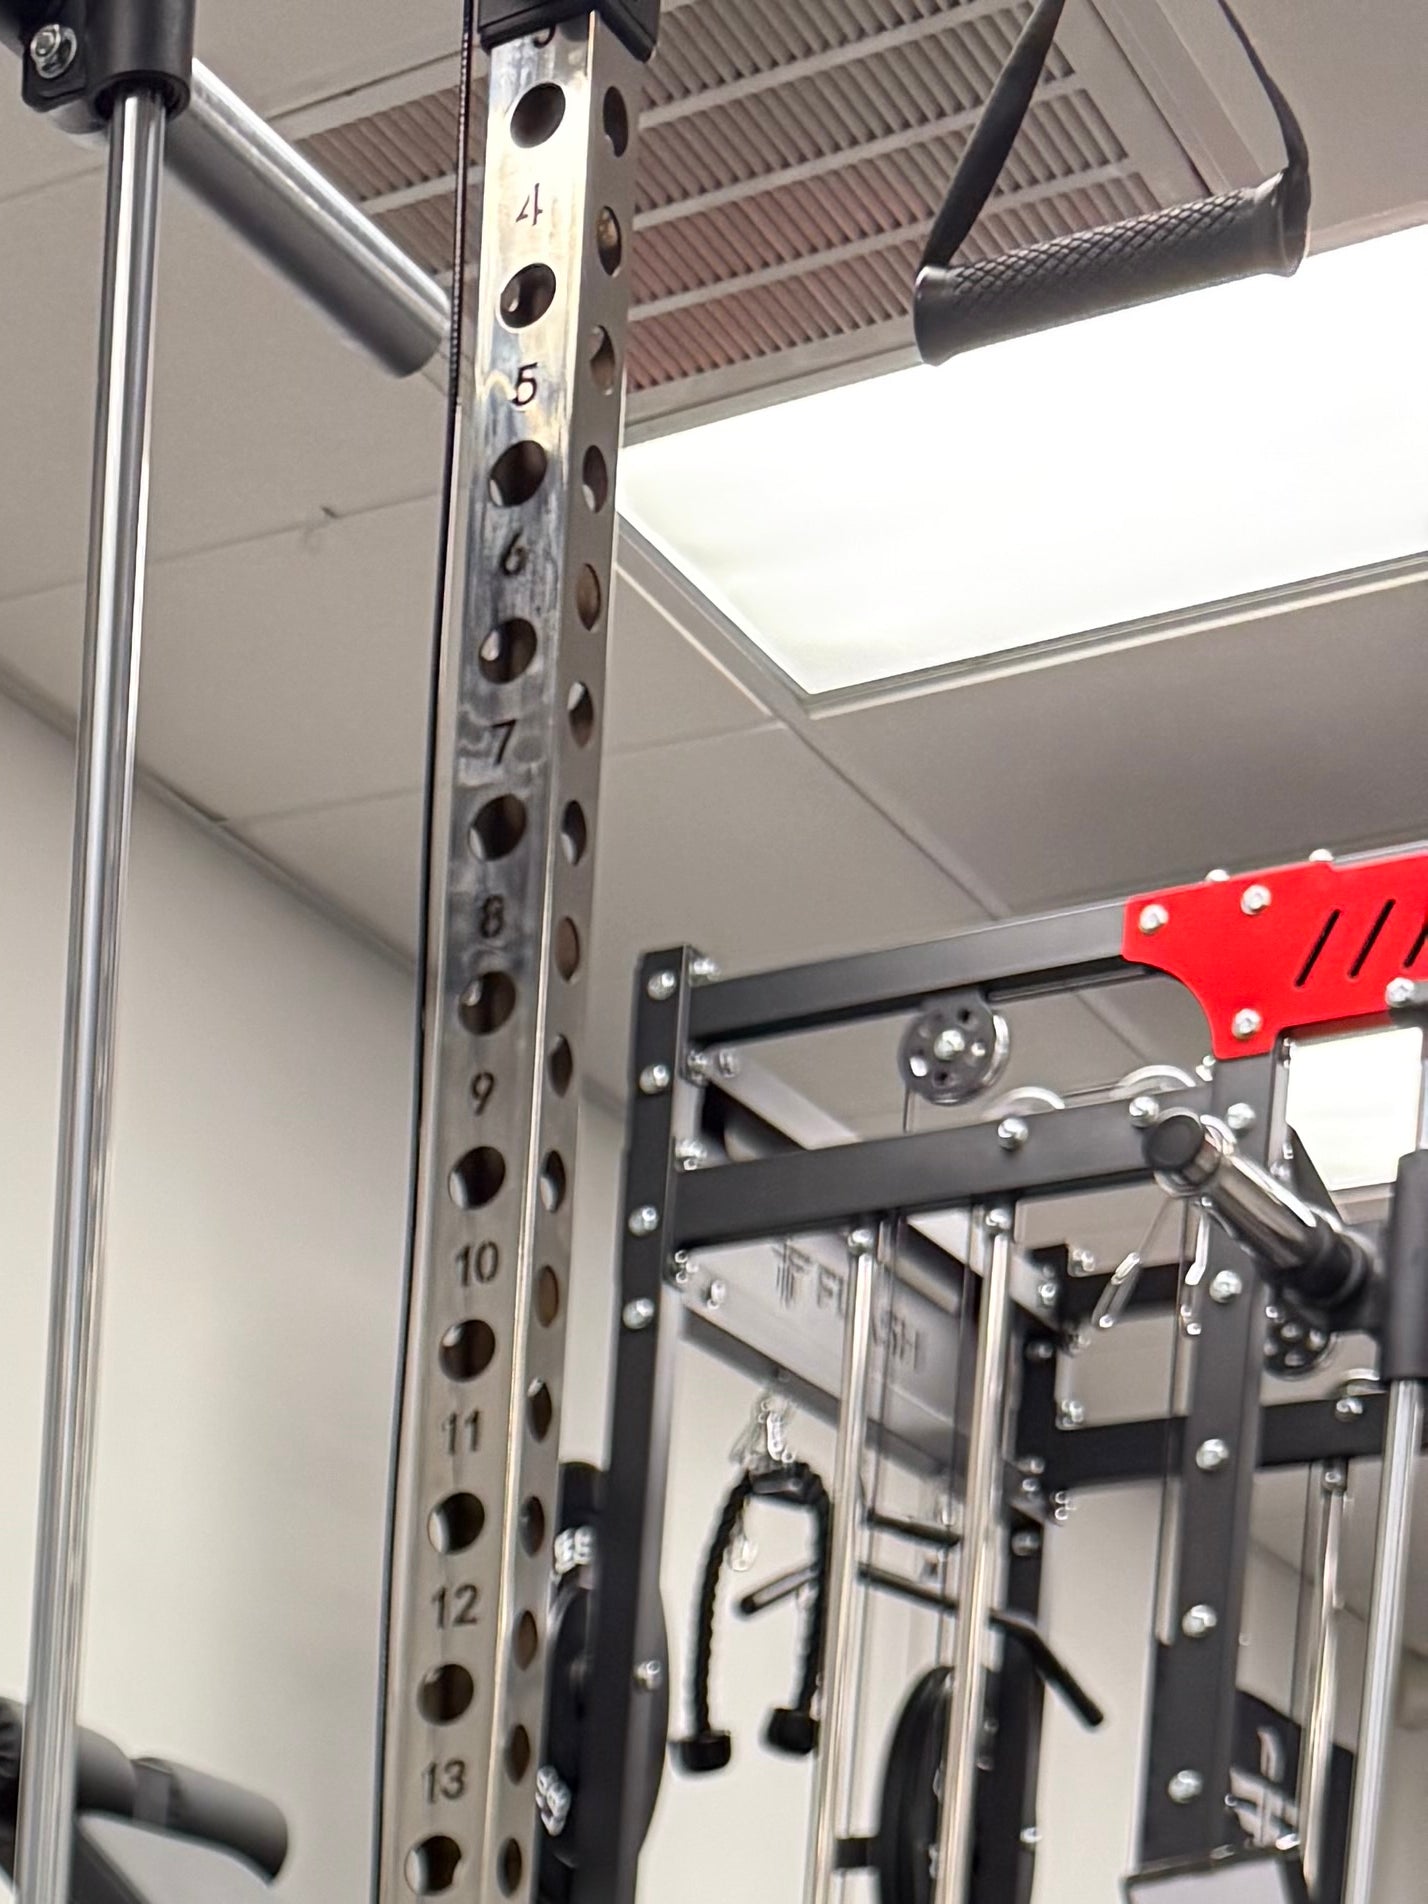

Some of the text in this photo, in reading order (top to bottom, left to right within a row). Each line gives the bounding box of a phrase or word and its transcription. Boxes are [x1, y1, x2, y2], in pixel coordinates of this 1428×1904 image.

[515, 183, 544, 226] 4
[512, 362, 539, 406] 5
[500, 533, 527, 577] 6
[491, 718, 517, 766] 7
[480, 894, 504, 939] 8
[471, 1071, 495, 1116] 9
[455, 1240, 499, 1287] 10
[441, 1409, 481, 1454] 11
[430, 1584, 478, 1629] 12
[420, 1759, 466, 1804] 13
